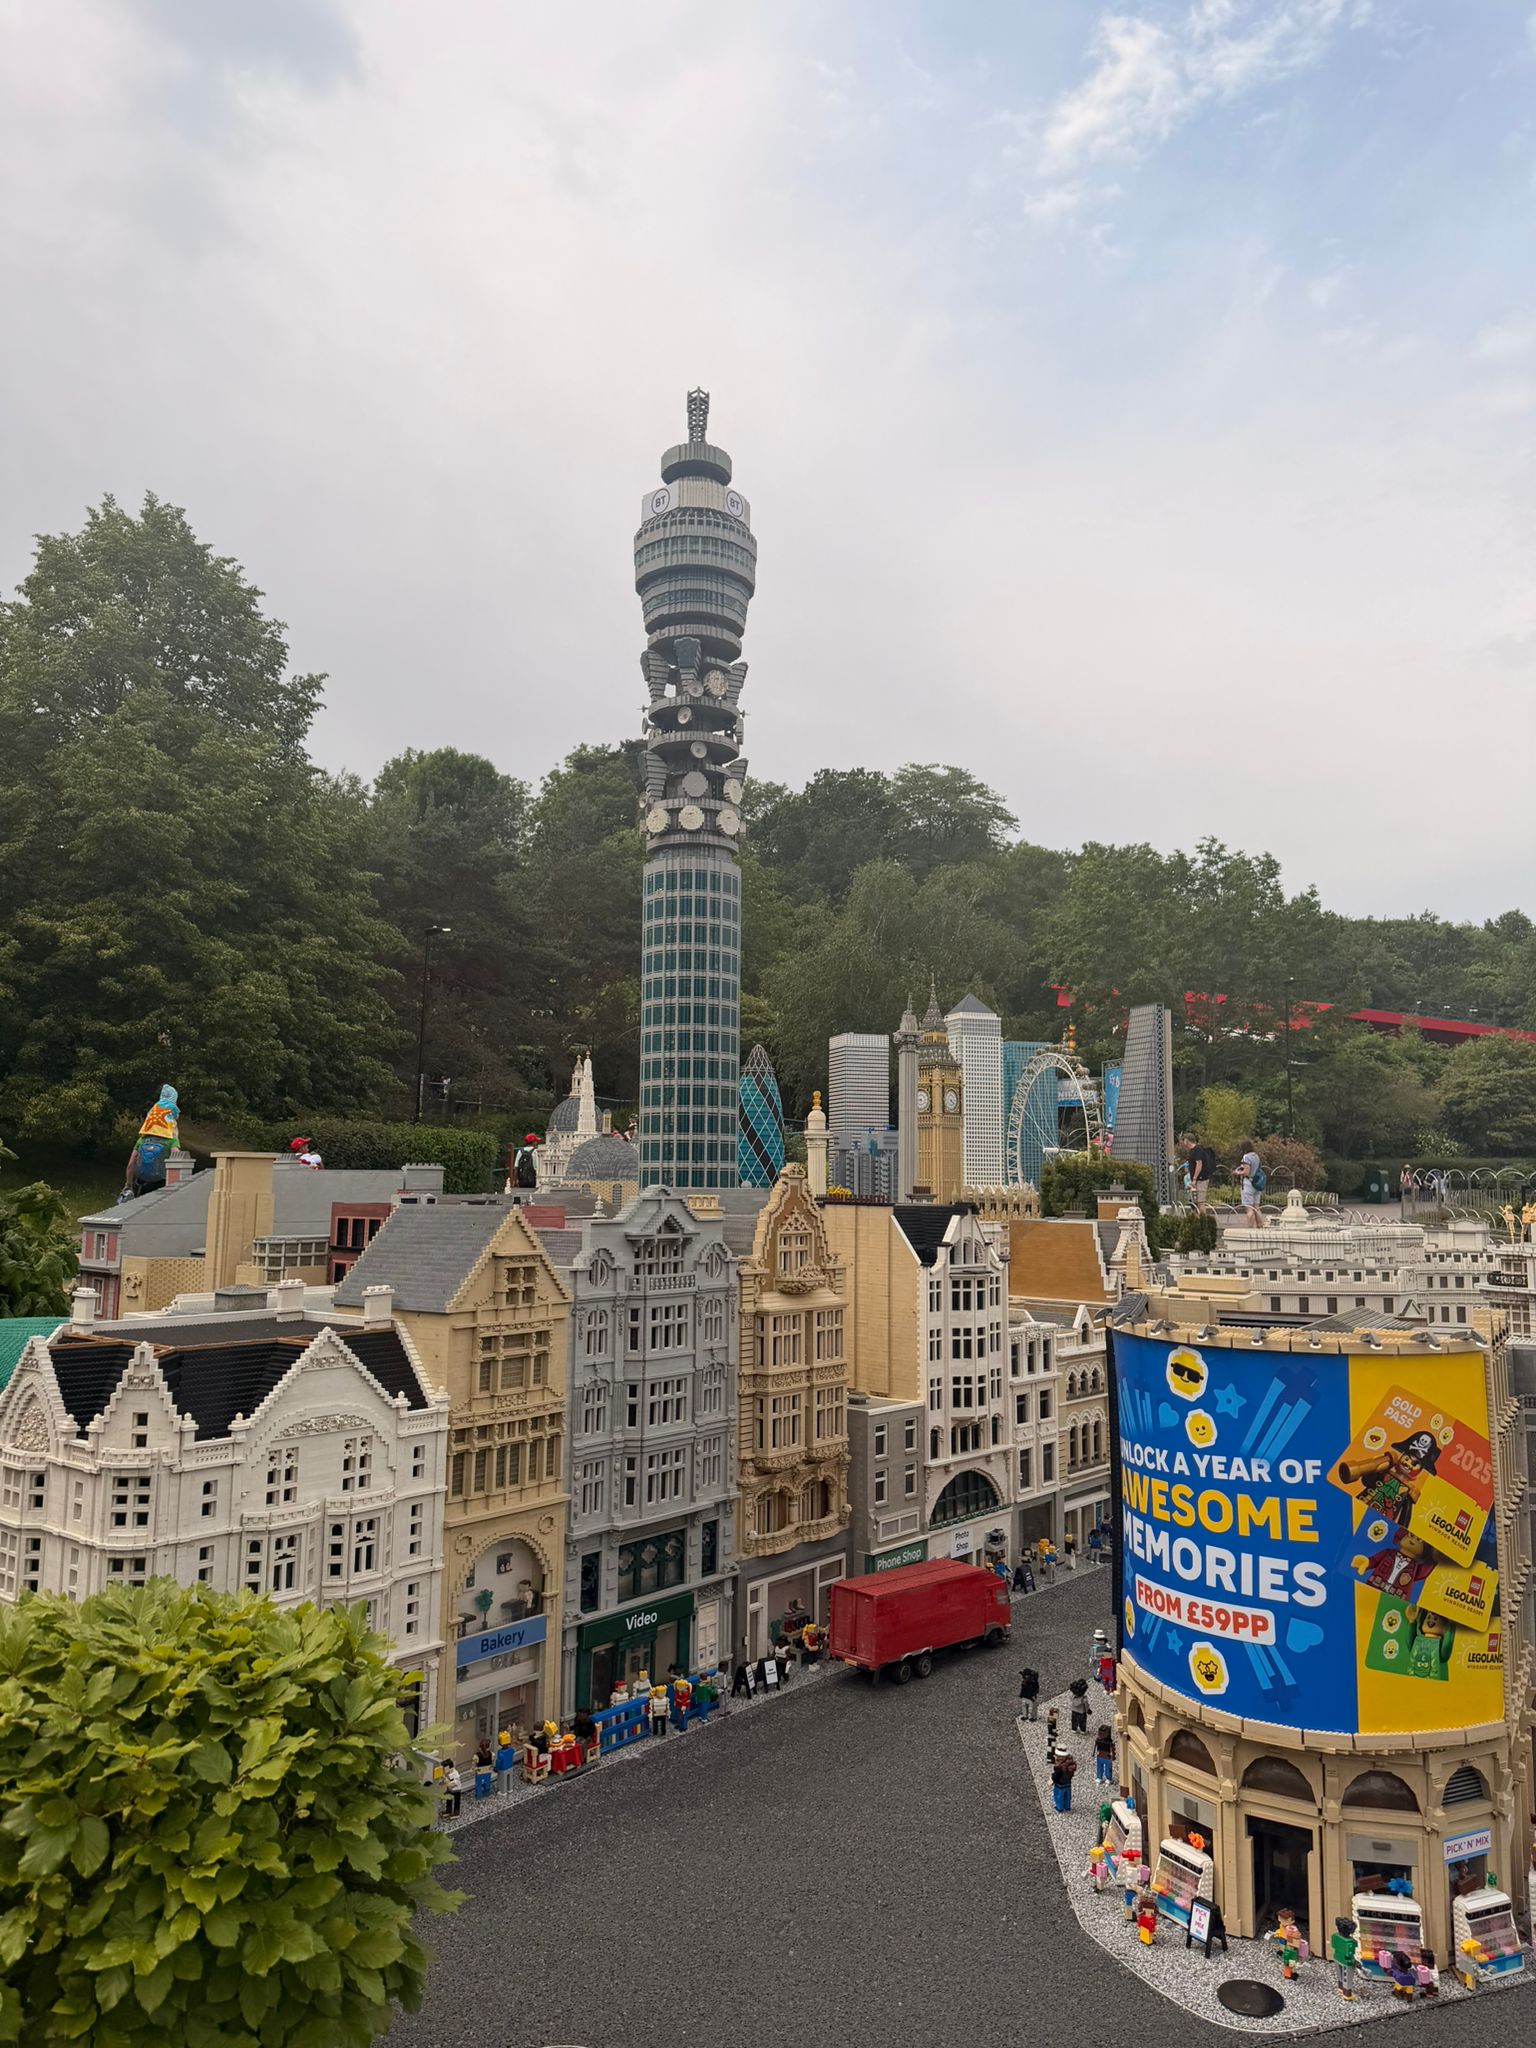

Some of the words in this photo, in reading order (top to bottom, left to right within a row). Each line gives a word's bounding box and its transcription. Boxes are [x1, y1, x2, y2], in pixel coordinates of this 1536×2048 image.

[655, 495, 666, 507] BT
[730, 497, 740, 510] BT
[1384, 1407, 1414, 1429] PASS
[1392, 1396, 1422, 1418] GOLD
[1173, 1451, 1190, 1476] A
[1192, 1453, 1272, 1483] YEAR
[1279, 1458, 1322, 1484] OF
[1450, 1443, 1492, 1485] 2025
[1122, 1464, 1319, 1542] AWESOME
[955, 1530, 969, 1540] Photo
[1431, 1513, 1471, 1546] LEGOLAND
[956, 1542, 969, 1551] Shop
[1123, 1503, 1327, 1607] MEMORIES
[877, 1556, 901, 1571] Phone
[902, 1549, 921, 1562] Shop
[1138, 1580, 1182, 1619] FROM
[1187, 1601, 1269, 1637] £59PP
[1445, 1586, 1486, 1610] LEGOLAND
[626, 1612, 658, 1630] Video
[481, 1629, 526, 1653] Bakery
[1468, 1652, 1504, 1663] LEGOLAND
[1446, 1843, 1464, 1855] PICK
[1475, 1836, 1489, 1846] MIX
[1195, 1907, 1207, 1917] PICK
